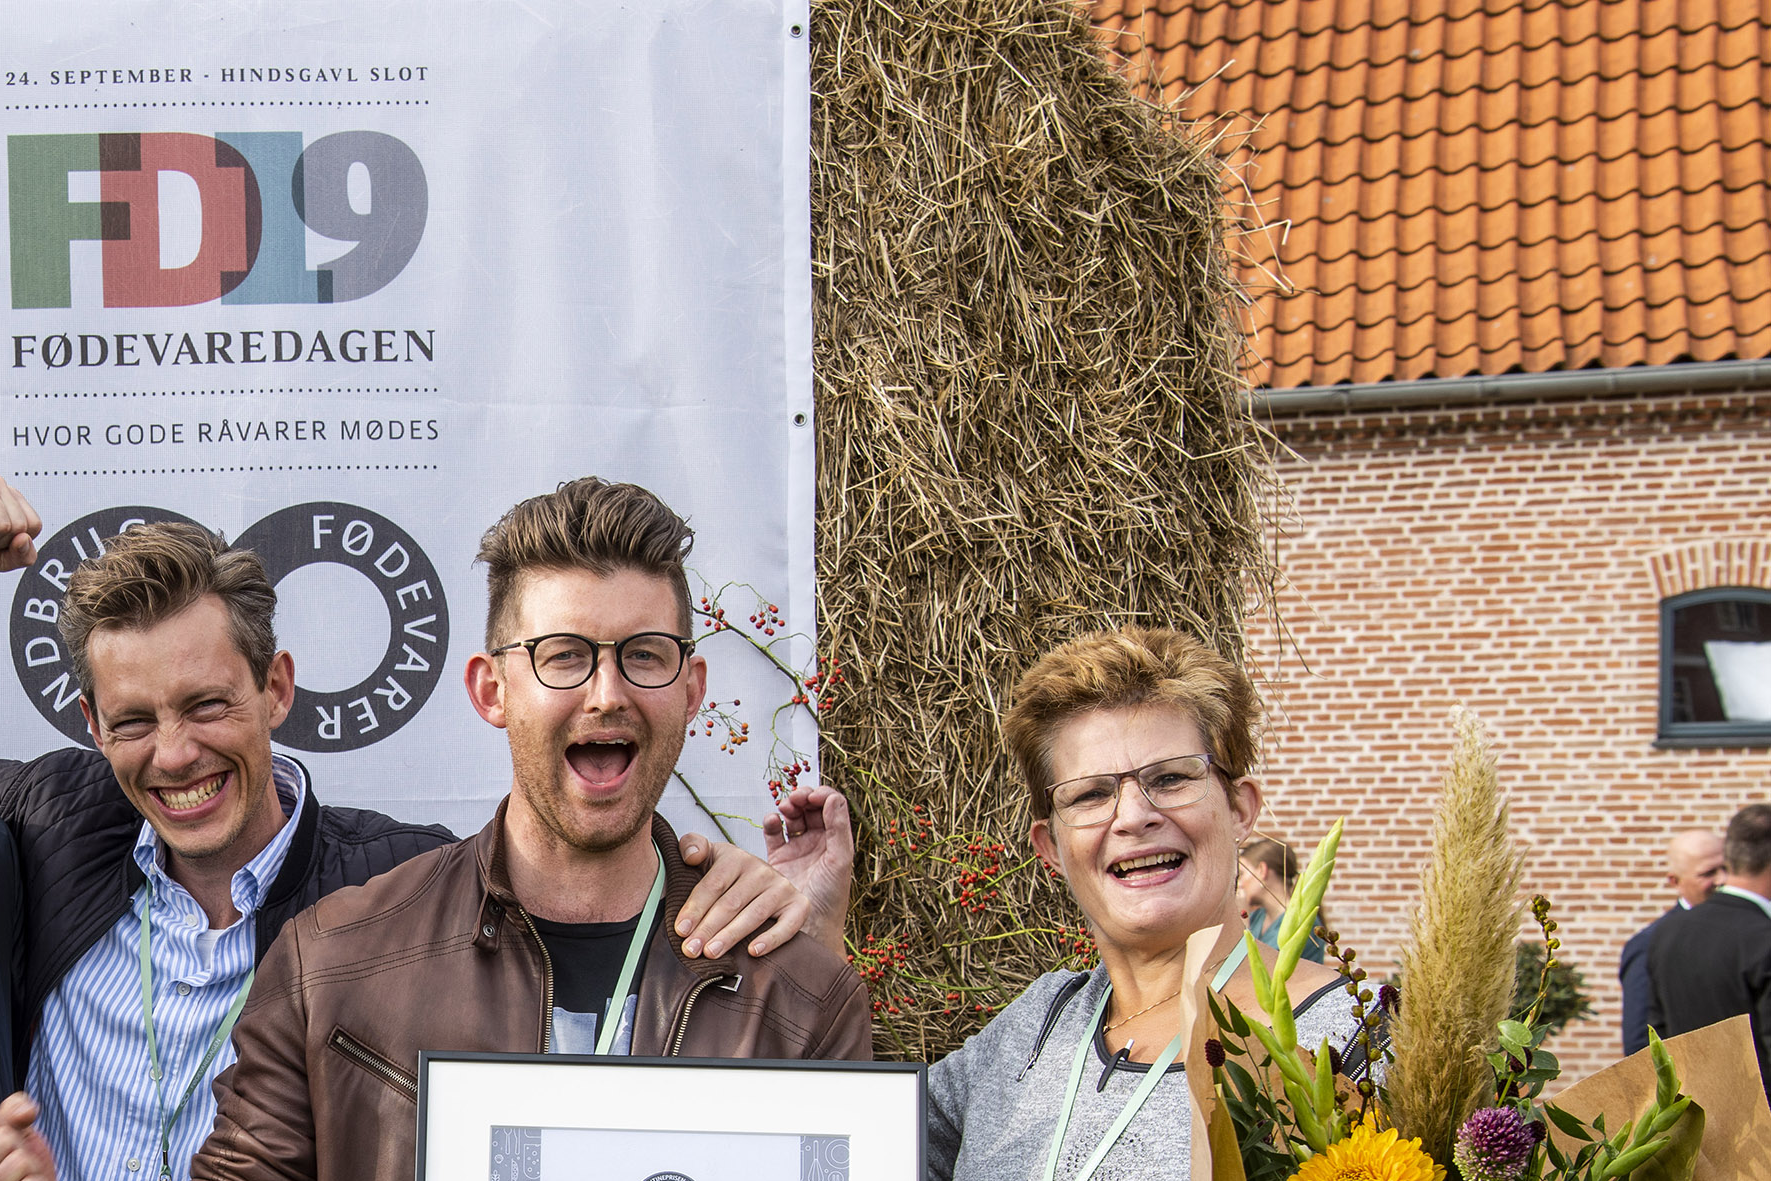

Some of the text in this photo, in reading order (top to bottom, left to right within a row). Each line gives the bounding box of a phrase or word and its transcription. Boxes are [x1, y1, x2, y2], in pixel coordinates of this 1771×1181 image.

[5, 71, 39, 86] 24.
[50, 68, 193, 85] SEPTEMBER
[221, 67, 358, 83] HINDSGAVL
[370, 66, 430, 82] SLOT
[11, 329, 436, 371] FØDEVAREDAGEN
[13, 419, 439, 447] HVOR GODE RÅVARER MØDES
[312, 514, 437, 740] FØDEVARER
